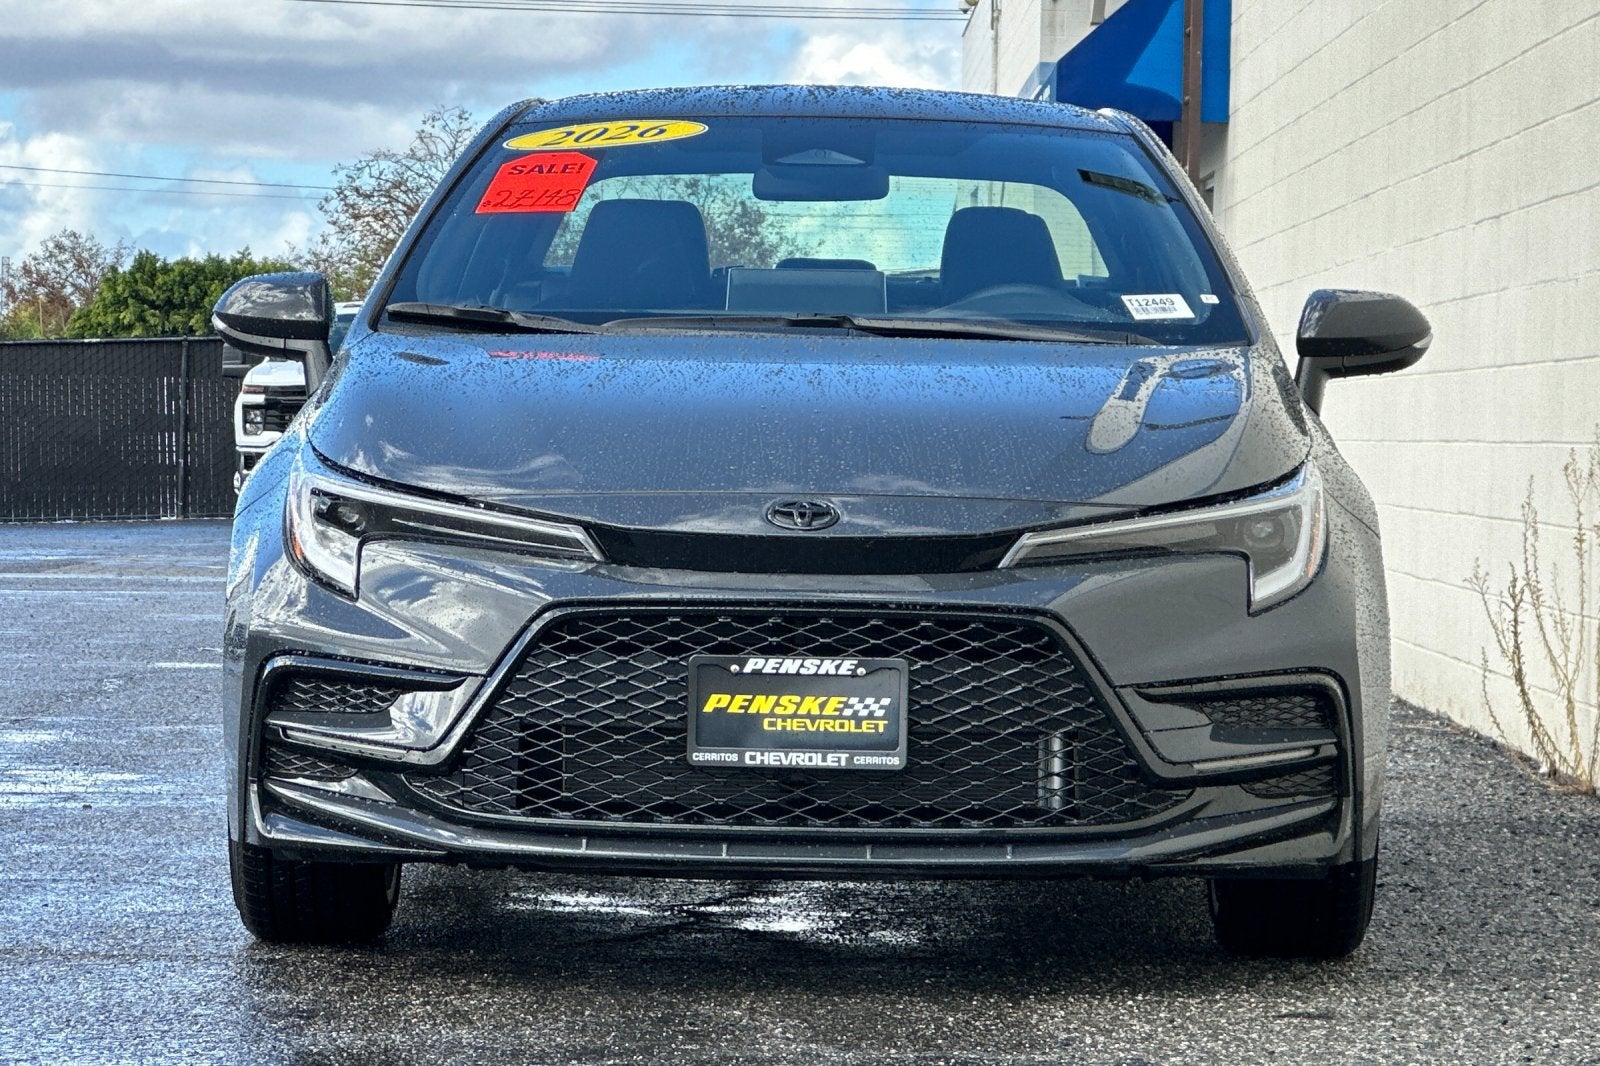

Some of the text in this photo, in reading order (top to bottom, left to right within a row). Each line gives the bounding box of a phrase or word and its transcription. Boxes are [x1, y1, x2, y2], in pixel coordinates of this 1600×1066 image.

[536, 121, 680, 147] 2026
[508, 162, 586, 176] SALE!
[1127, 298, 1175, 307] T12449
[743, 658, 858, 675] PENSKE
[703, 693, 848, 716] PENSKE
[763, 718, 888, 733] CHEVROLET
[692, 751, 900, 767] CERRITOS CHEVROLET CERRITOS
